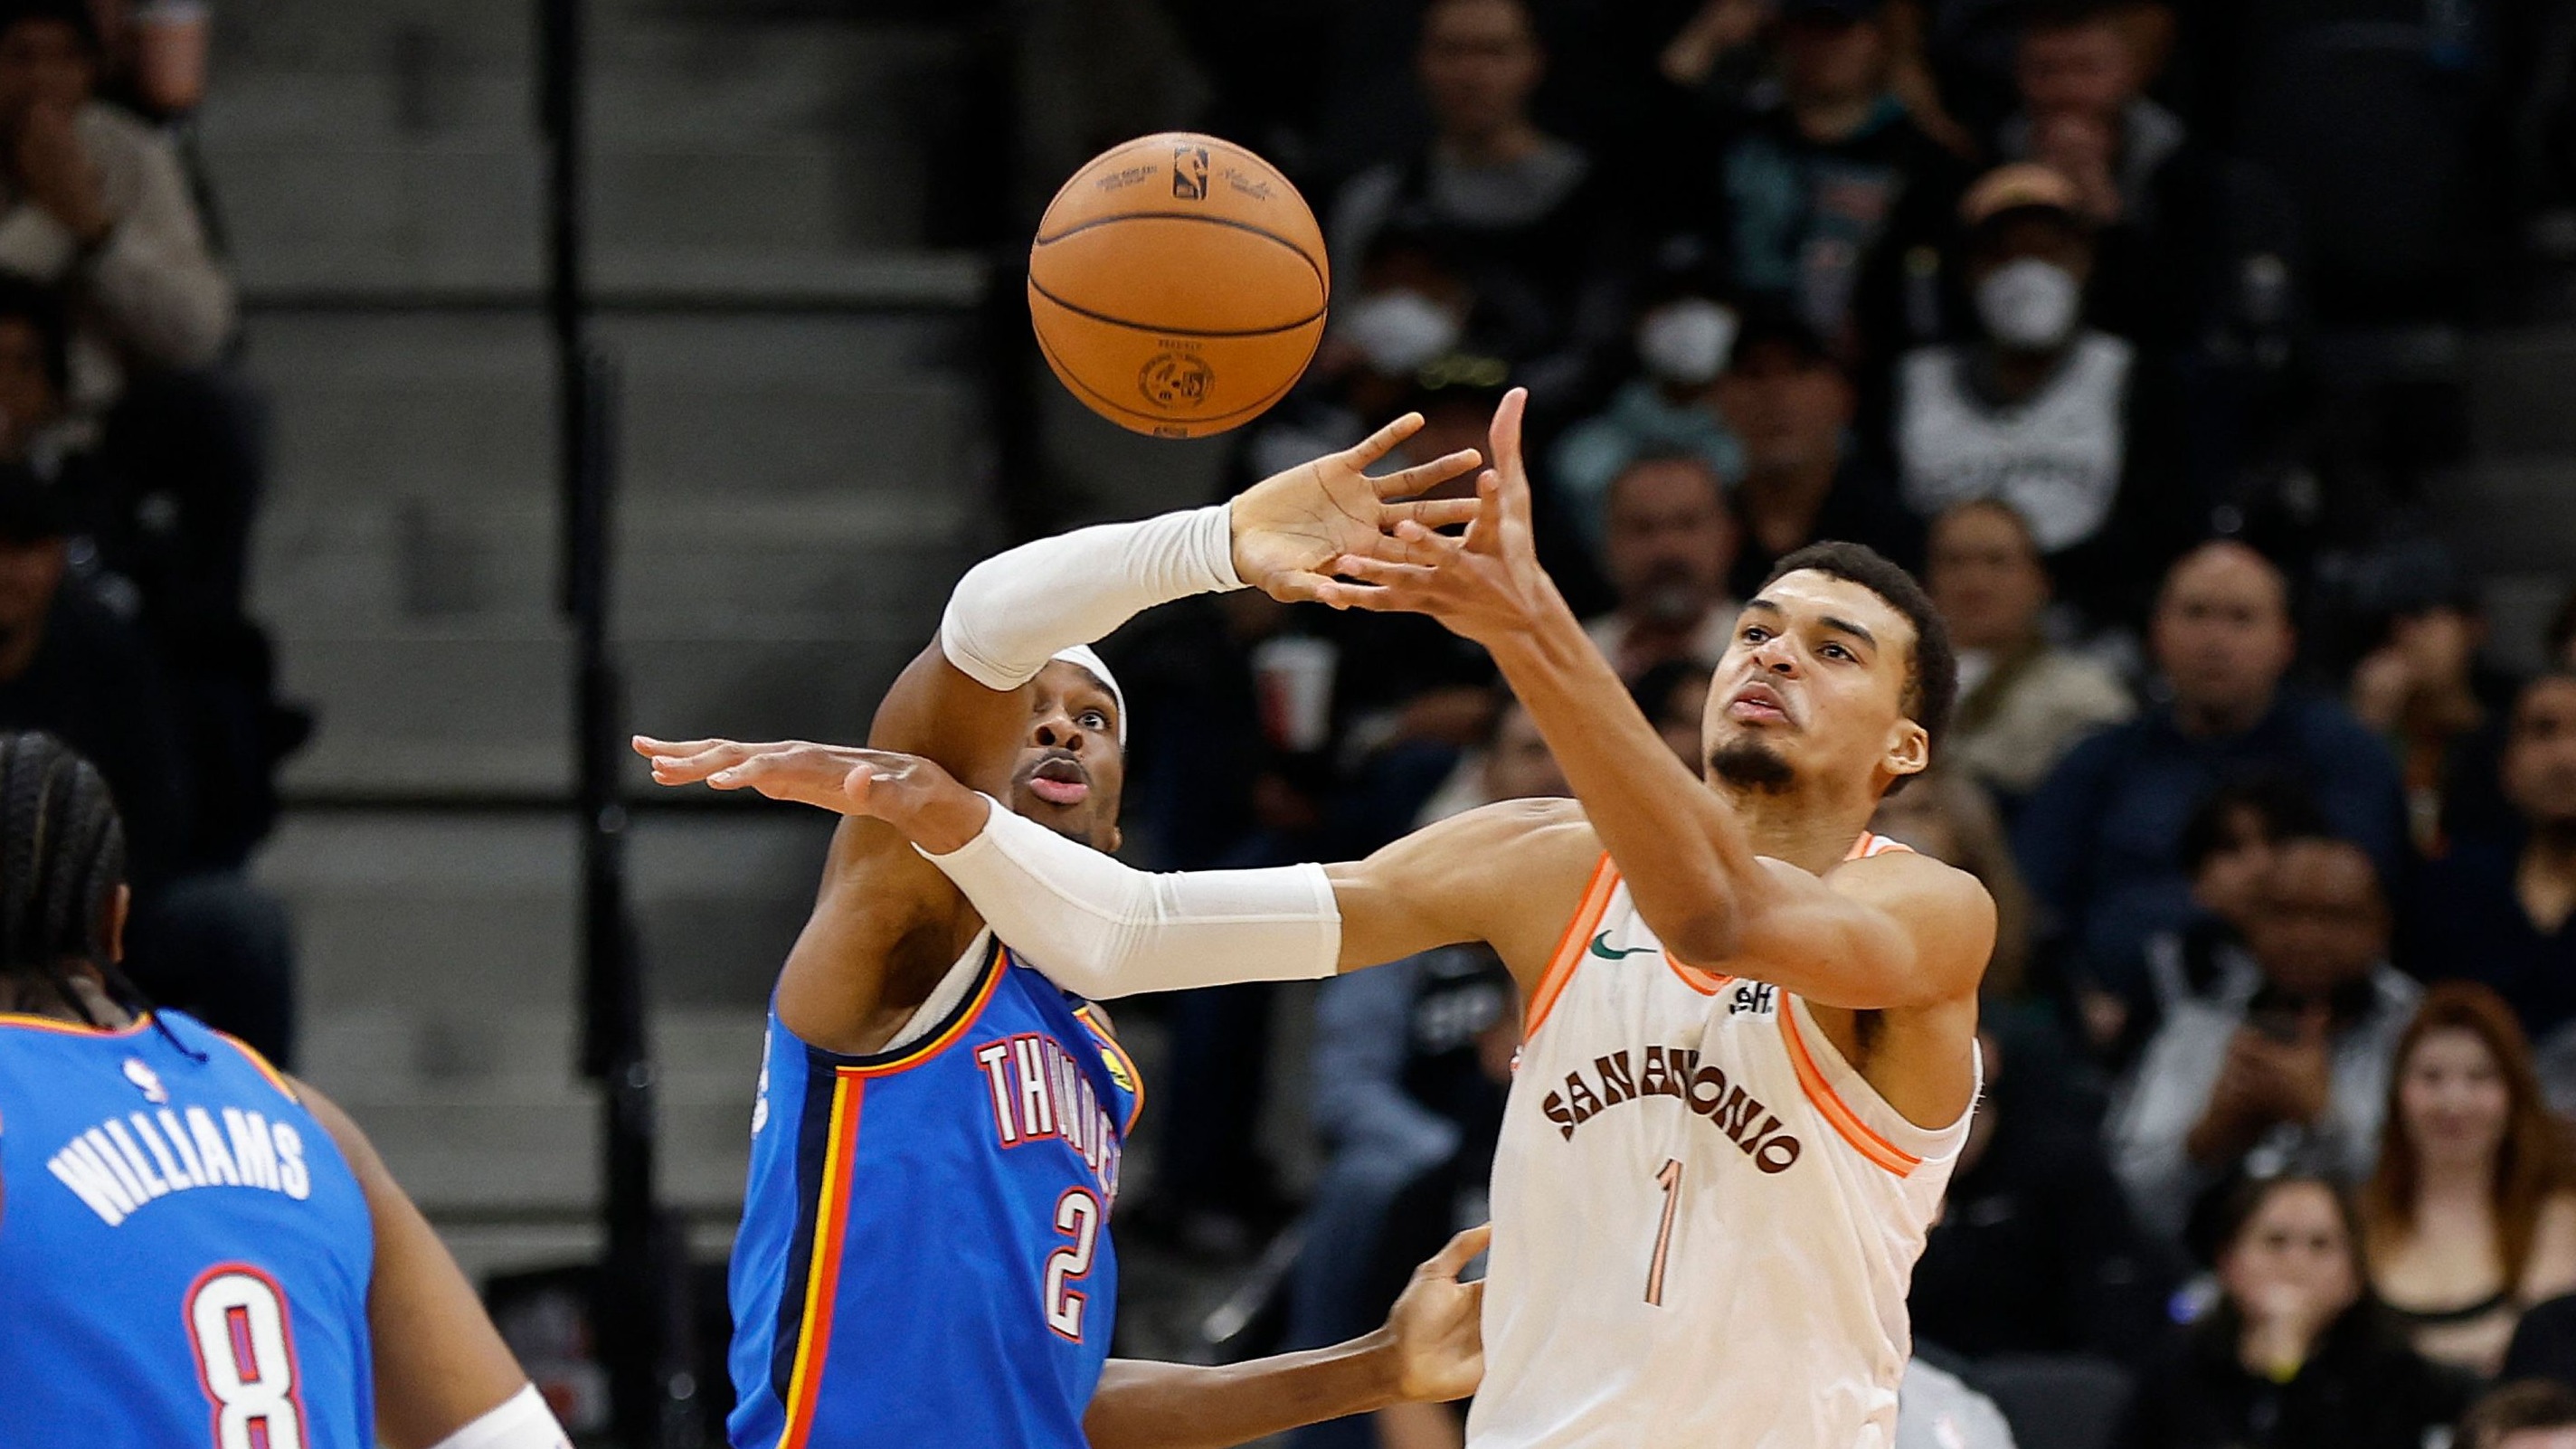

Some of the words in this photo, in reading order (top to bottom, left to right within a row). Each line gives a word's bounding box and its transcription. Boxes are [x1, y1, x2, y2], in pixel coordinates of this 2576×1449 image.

[47, 1106, 311, 1227] WILLIAMS
[1542, 1049, 1637, 1142] SAN
[1640, 1045, 1801, 1175] ANONIO
[1044, 1185, 1102, 1344] 2
[1643, 1158, 1683, 1308] 1
[182, 1261, 311, 1449] 8
